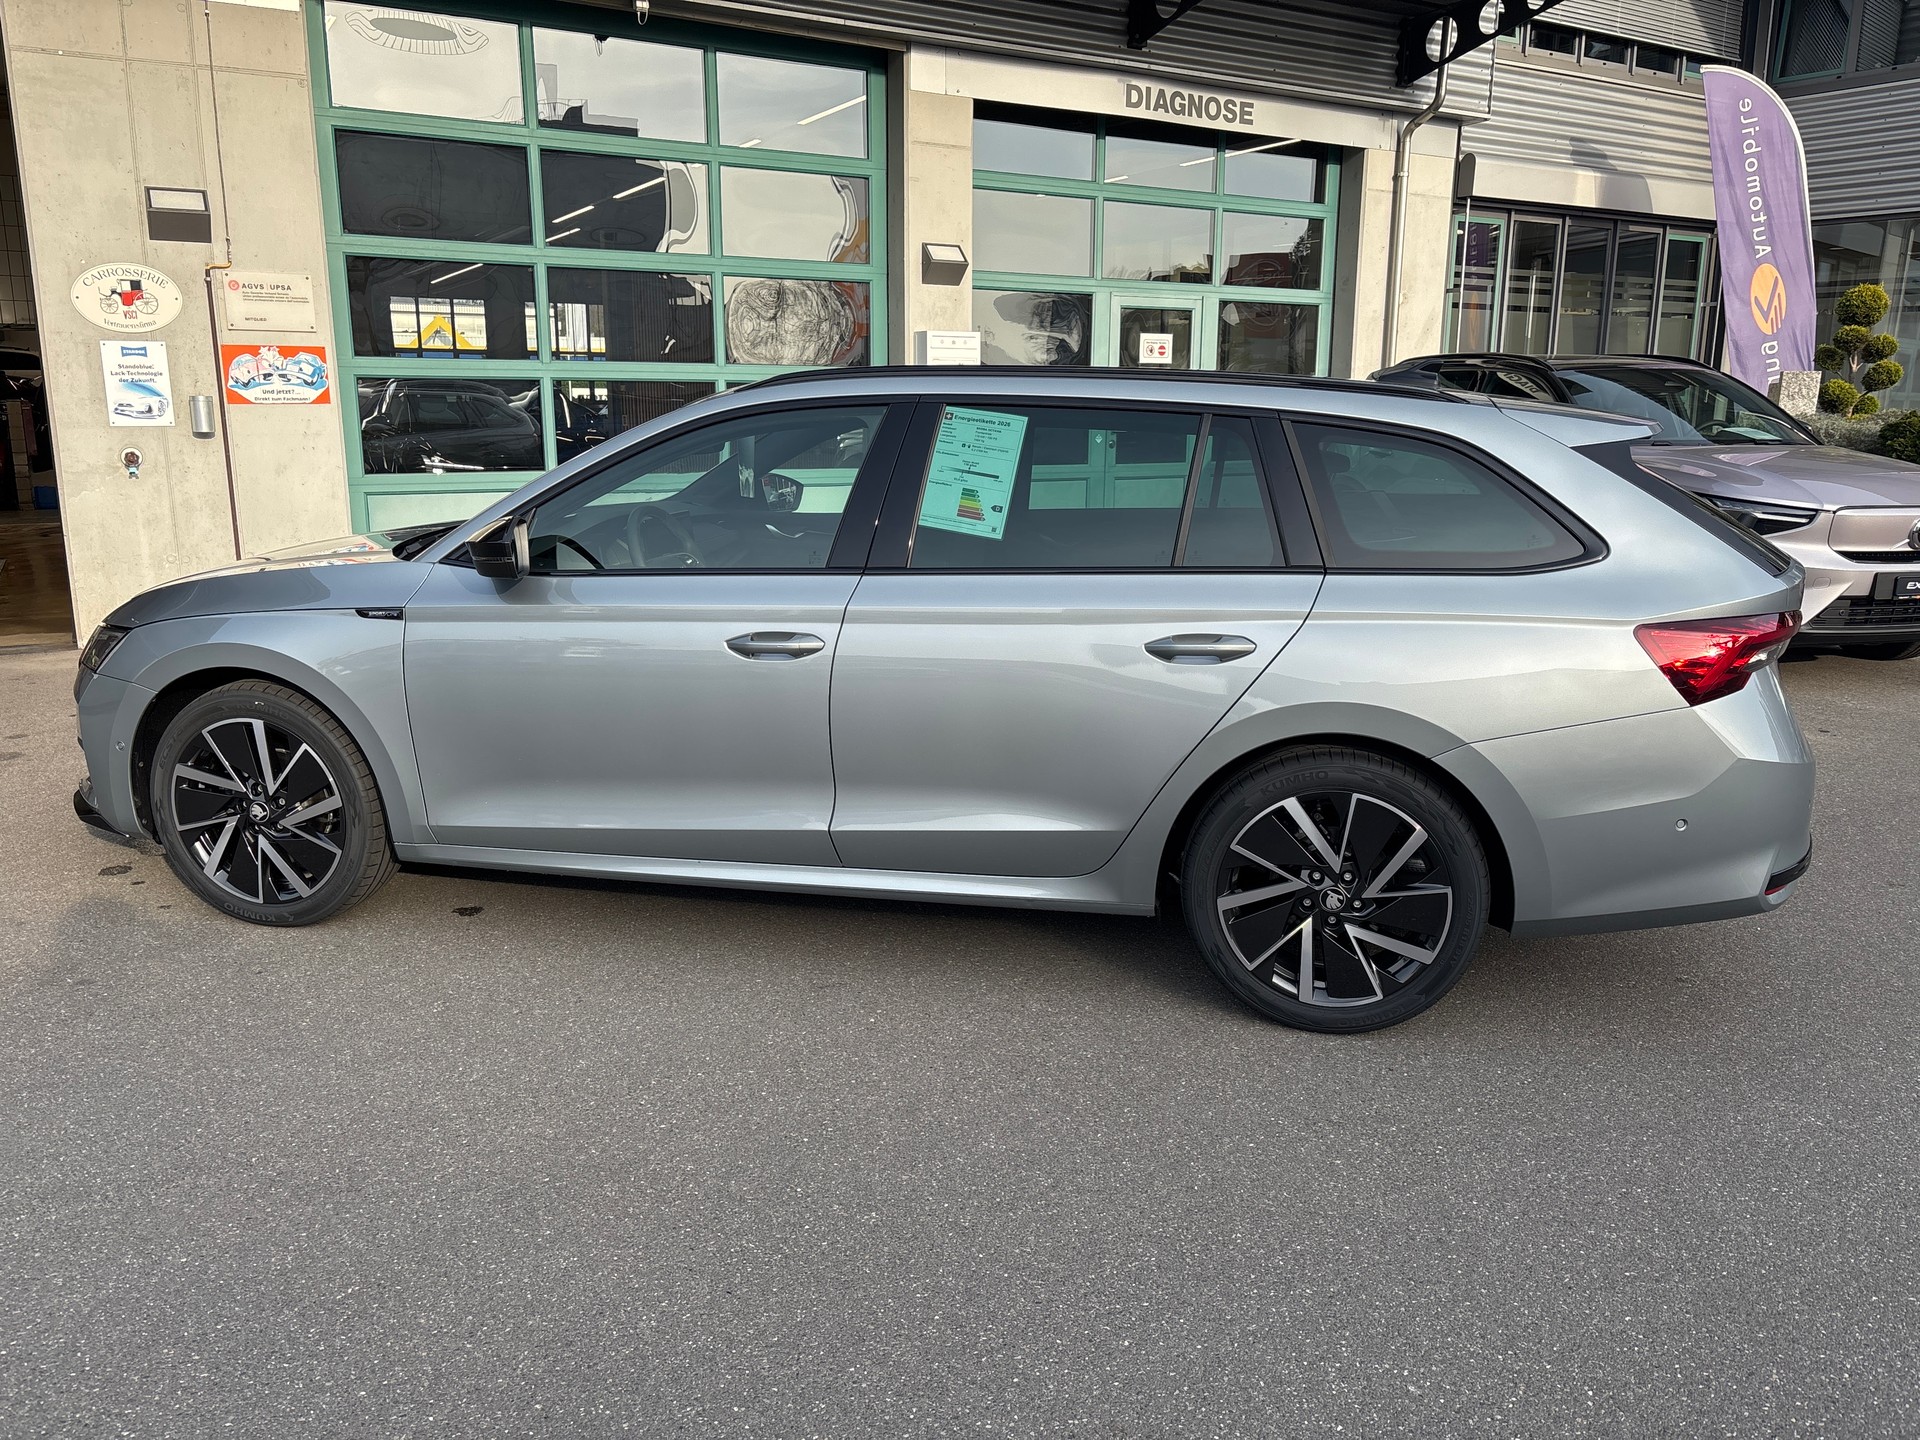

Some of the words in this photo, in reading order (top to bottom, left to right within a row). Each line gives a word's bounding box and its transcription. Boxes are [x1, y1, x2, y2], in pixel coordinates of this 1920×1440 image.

[1125, 83, 1254, 126] DIAGNOSE
[82, 267, 169, 289] CARROSSERIE
[103, 318, 157, 329] Vertrauensfirma
[123, 310, 138, 320] VSCI
[954, 414, 996, 426] Energieetikette
[1260, 770, 1329, 796] KUMHO
[224, 902, 276, 922] KUMHO
